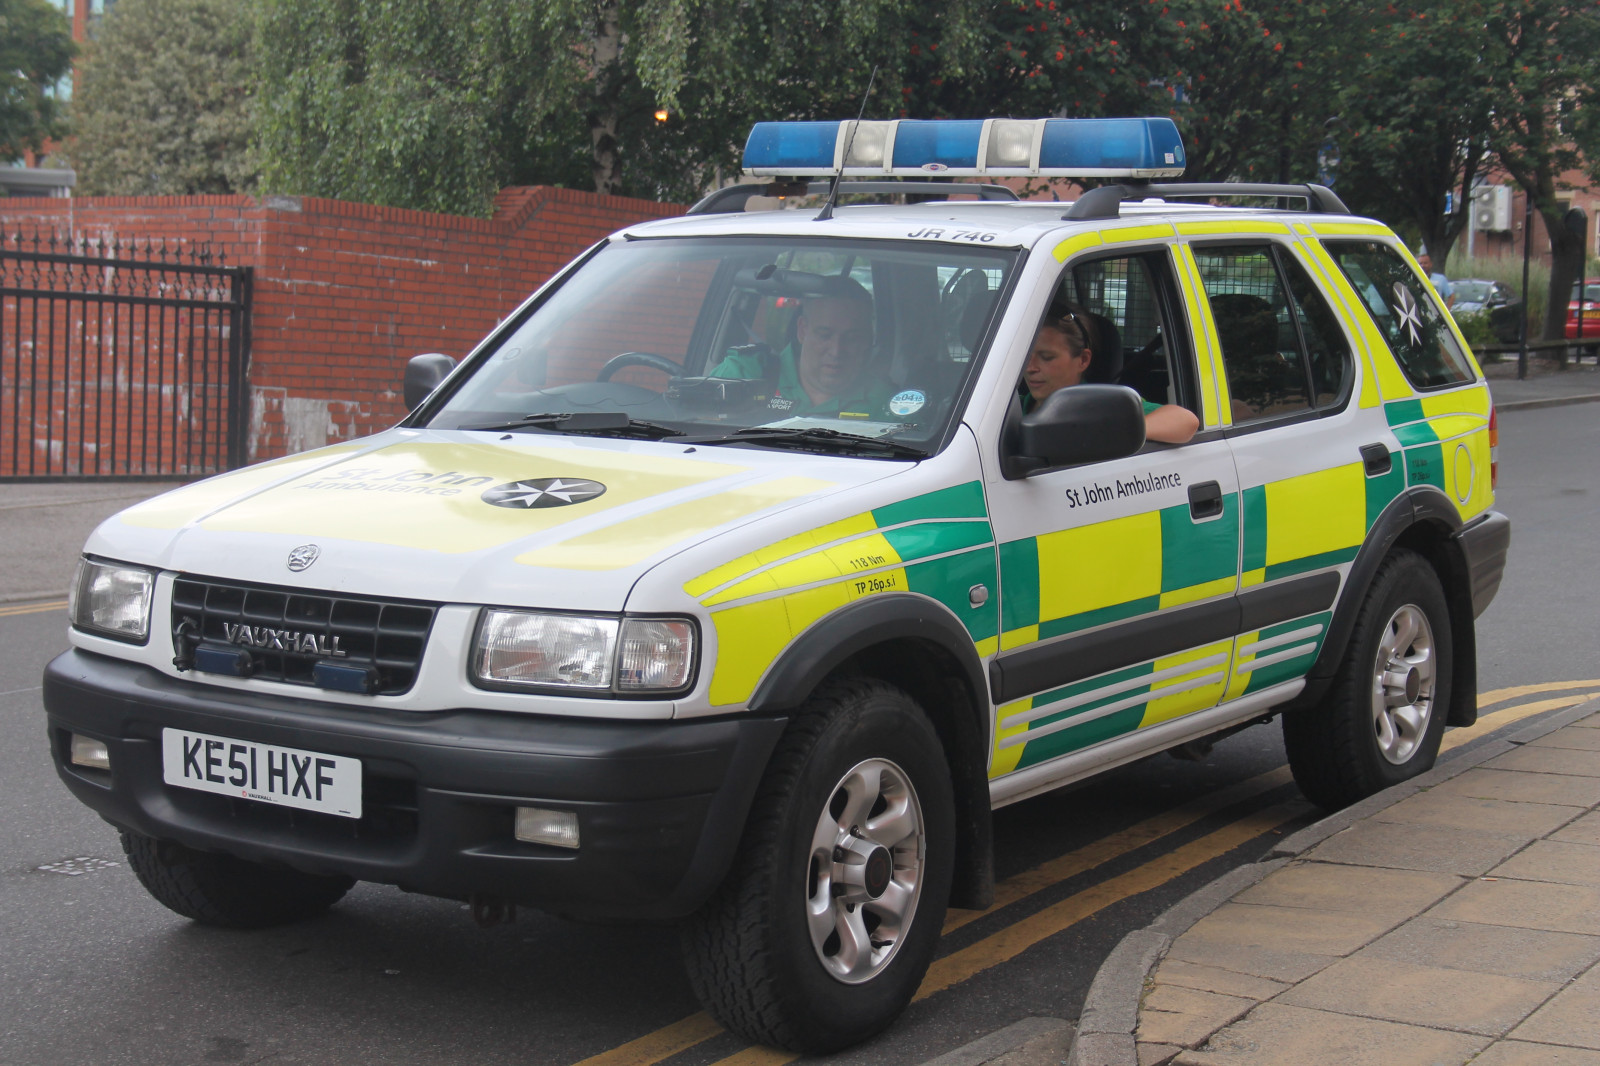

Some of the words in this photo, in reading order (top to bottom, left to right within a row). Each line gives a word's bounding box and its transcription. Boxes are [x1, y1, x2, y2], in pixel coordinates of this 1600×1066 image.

[907, 227, 946, 239] JR
[952, 230, 997, 243] 746
[321, 468, 382, 481] St
[371, 469, 494, 486] John
[293, 480, 462, 496] Ambulance
[1065, 488, 1082, 508] St
[1083, 482, 1114, 505] John
[1116, 472, 1182, 499] Ambulance
[850, 557, 869, 570] 118
[867, 555, 886, 566] Nm
[855, 581, 866, 594] TP
[868, 574, 896, 592] 26p.s.i
[223, 622, 346, 656] VAUXHALL
[183, 735, 258, 790] KE51
[267, 750, 336, 801] HXF
